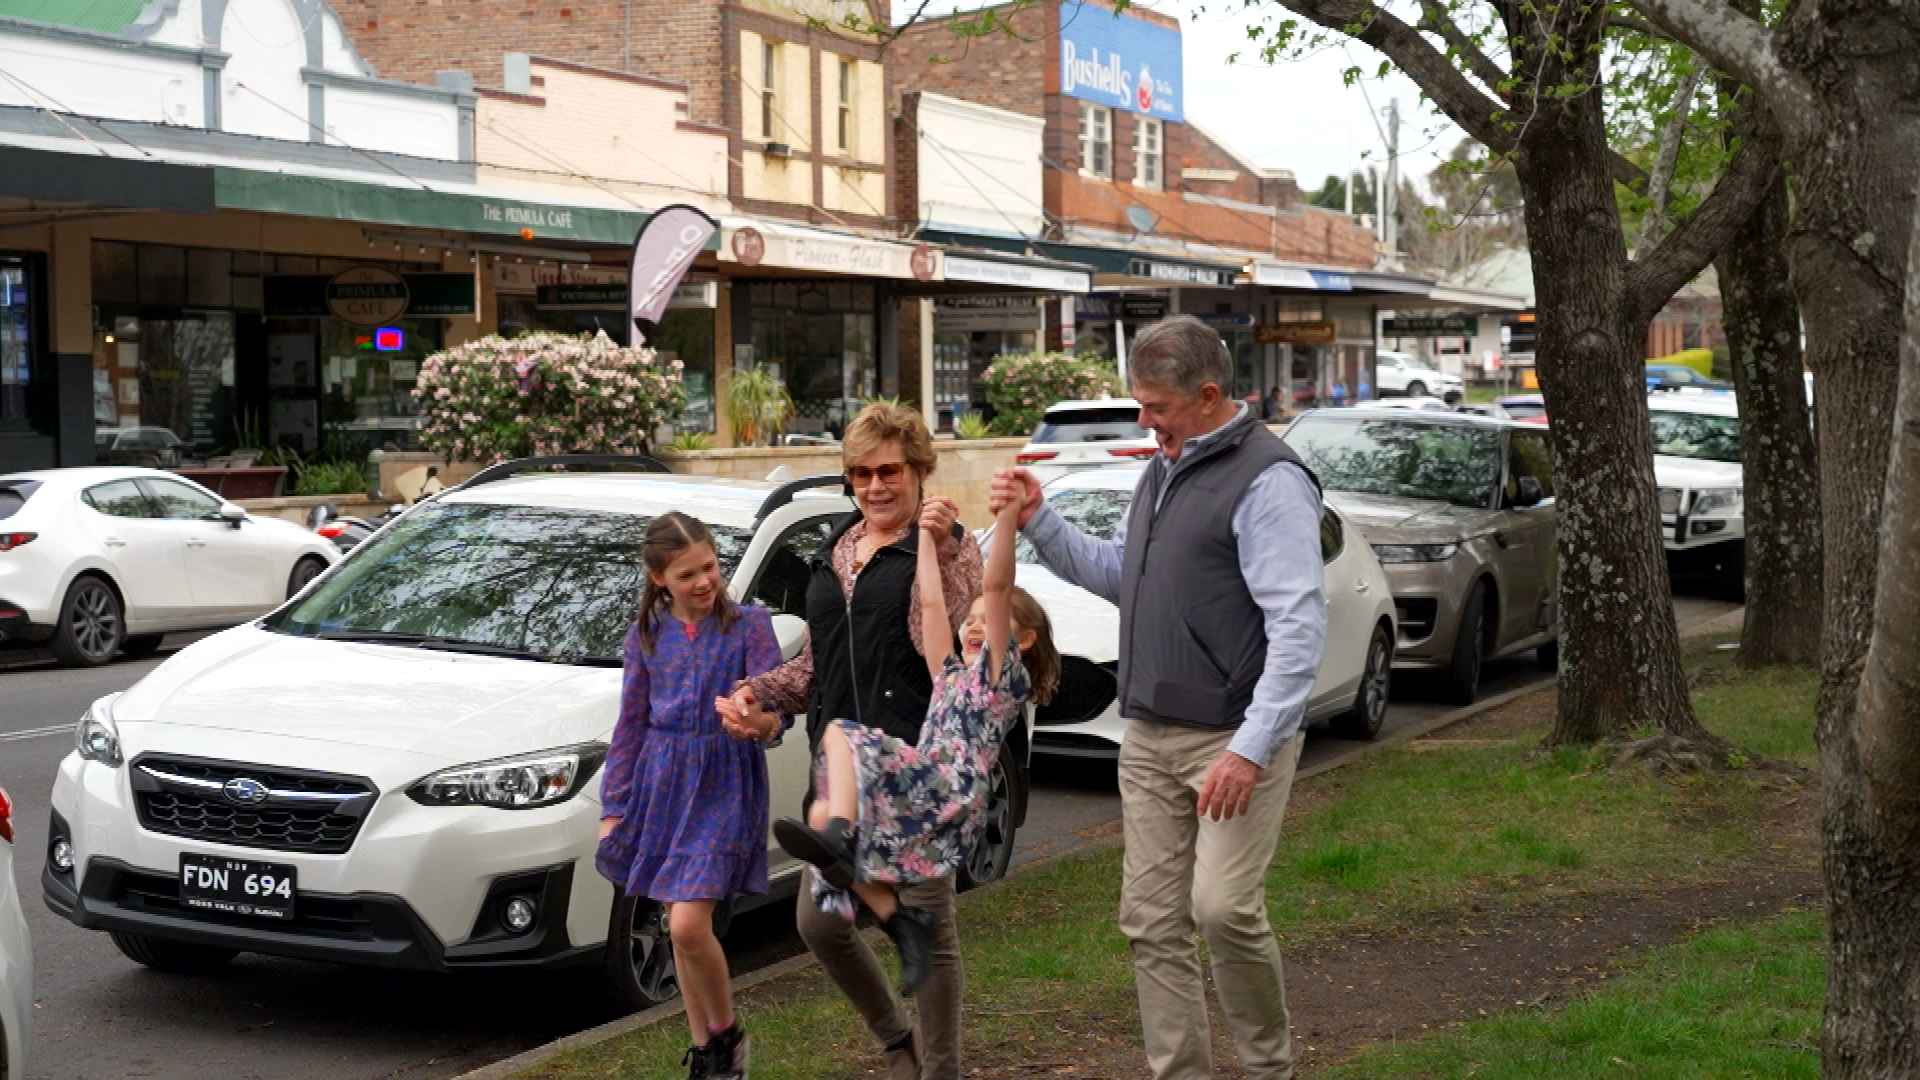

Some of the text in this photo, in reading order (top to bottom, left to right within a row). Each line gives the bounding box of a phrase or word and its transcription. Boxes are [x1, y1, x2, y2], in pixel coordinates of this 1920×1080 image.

[1063, 39, 1132, 107] Bushells
[183, 864, 292, 899] FDN 694
